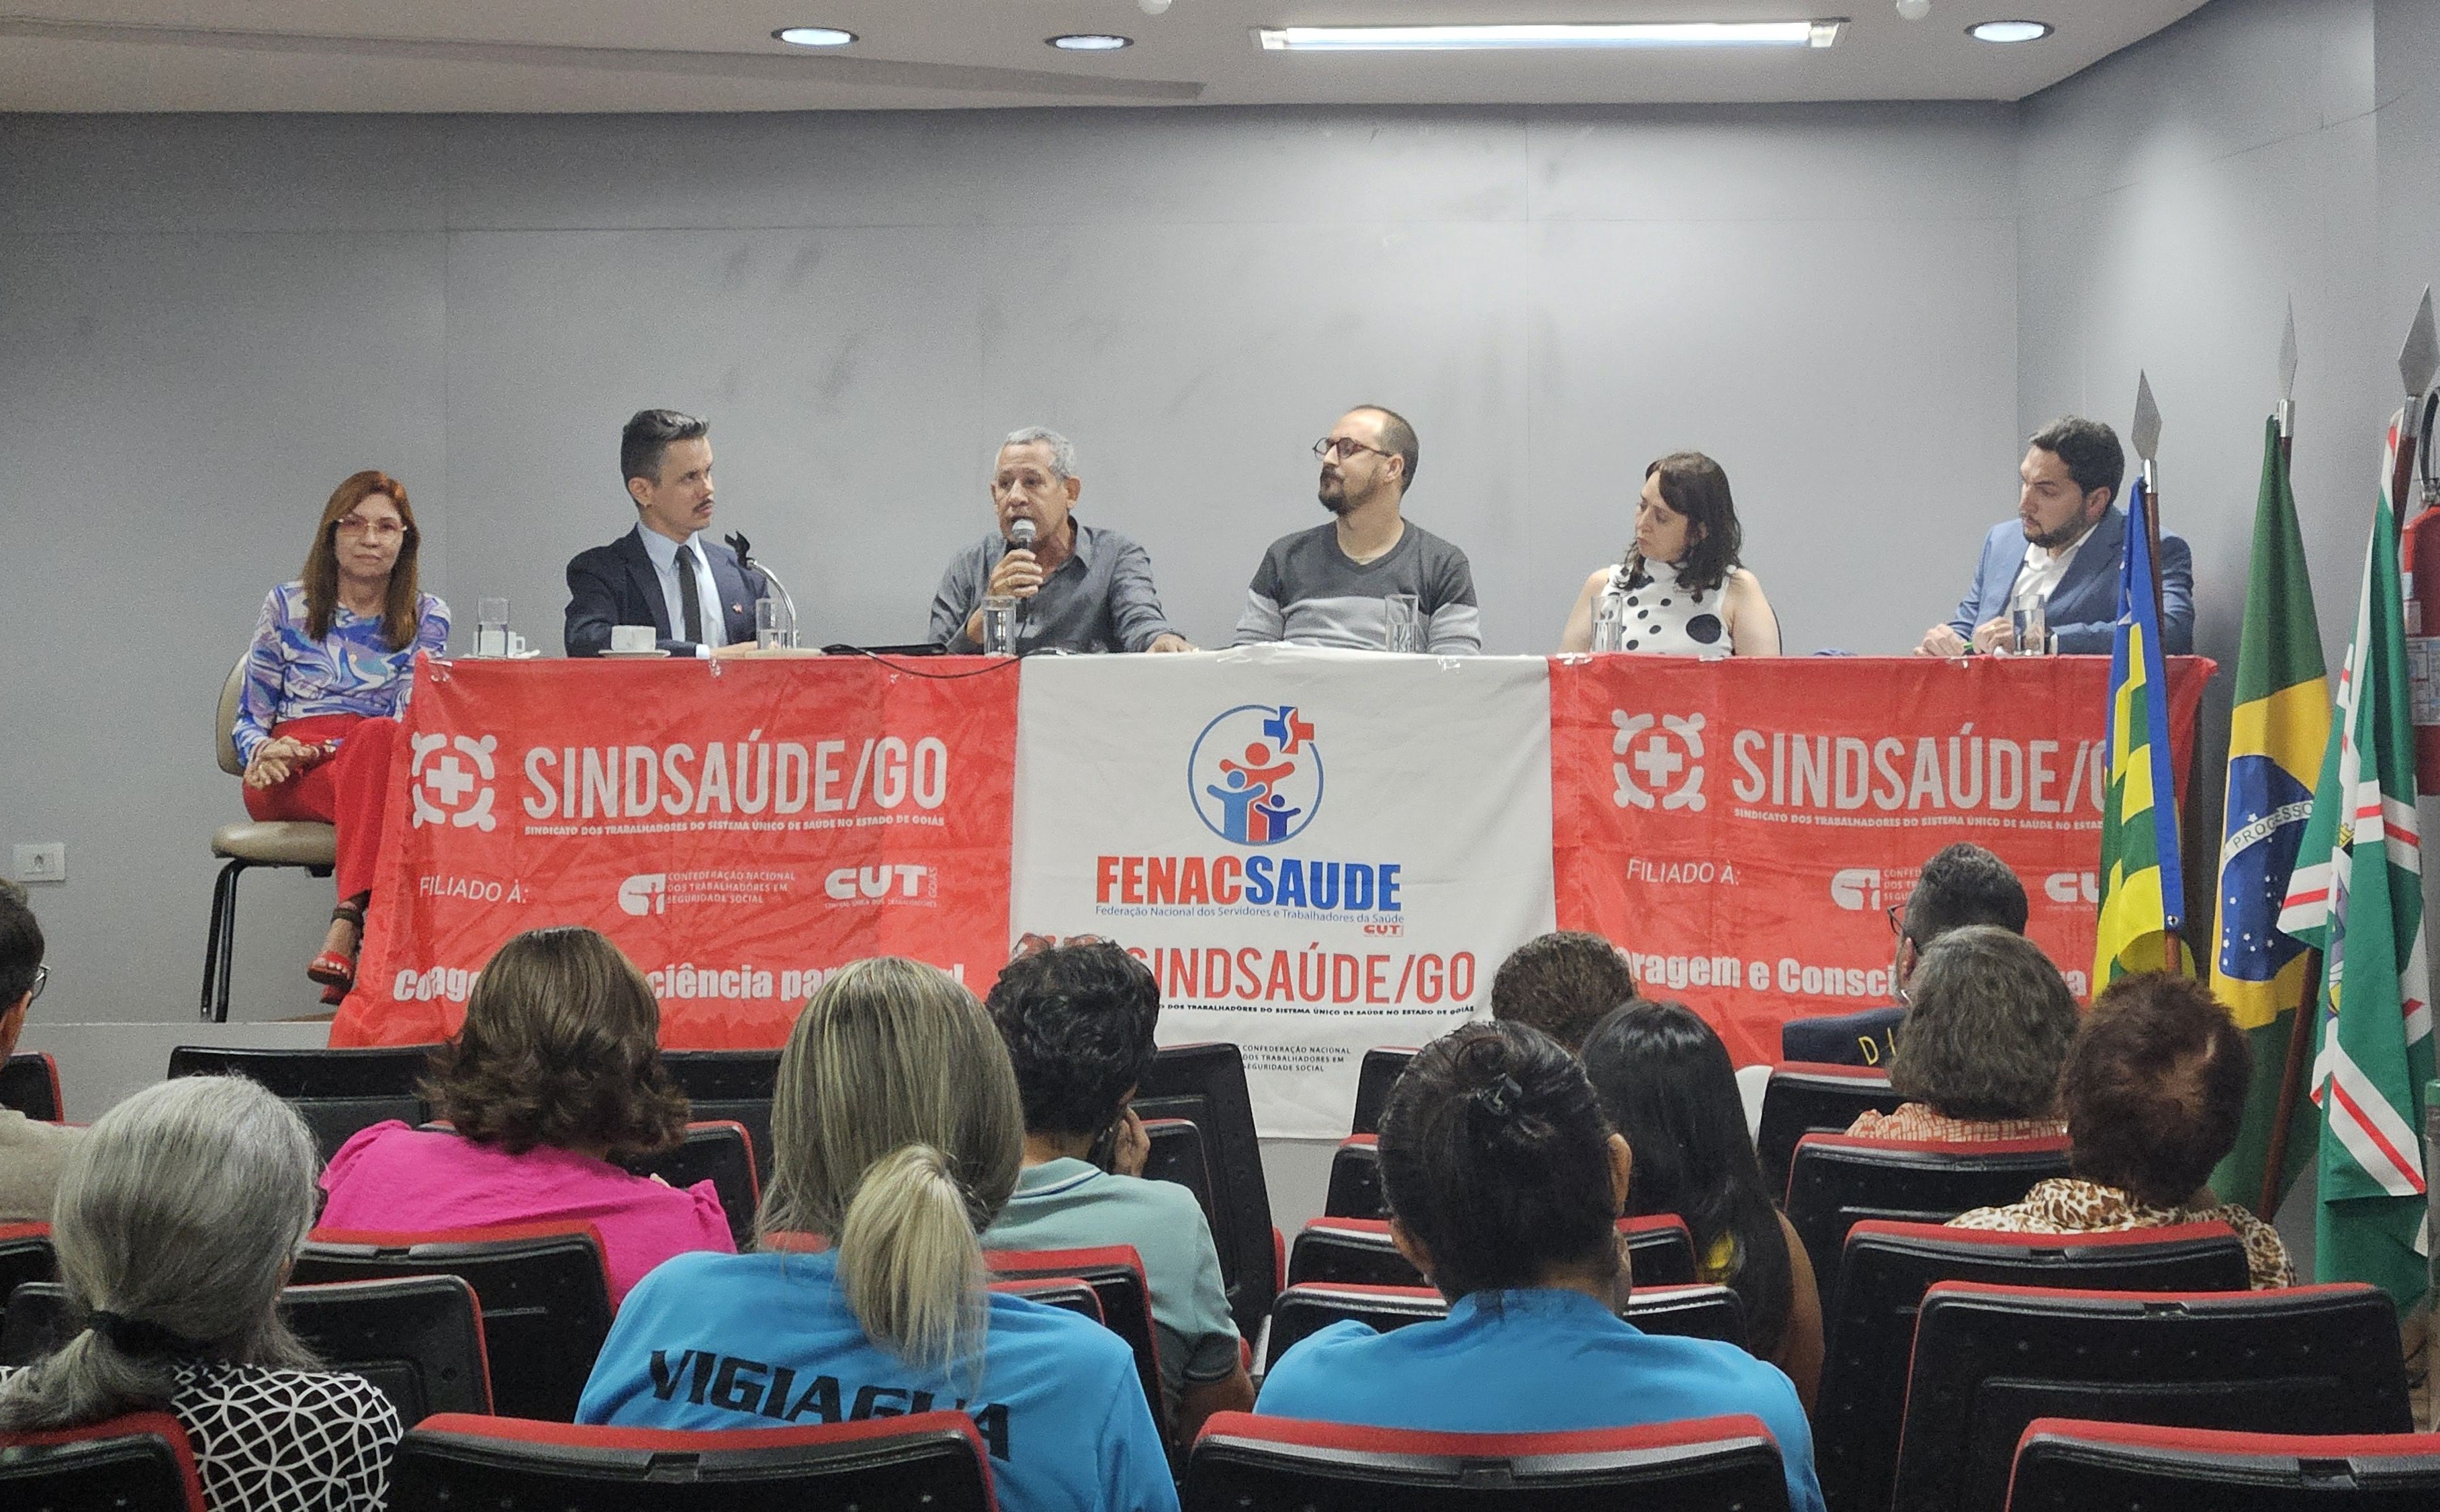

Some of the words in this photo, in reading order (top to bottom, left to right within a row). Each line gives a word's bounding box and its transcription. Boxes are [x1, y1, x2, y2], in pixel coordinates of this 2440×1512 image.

[523, 729, 947, 819] SINDSAÚDE/GO
[1732, 722, 2105, 814] SINDSAÚDE/
[524, 825, 578, 836] SINDICATO
[581, 825, 603, 836] DOS
[604, 821, 688, 835] TRABALHADORES
[689, 820, 705, 832] DO
[707, 819, 750, 831] SISTEMA
[752, 818, 784, 831] ÚNICO
[787, 820, 801, 831] DE
[803, 817, 835, 830] SAÚDE
[837, 818, 853, 829] NO
[856, 814, 893, 827] ESTADO
[896, 814, 909, 824] DE
[1733, 808, 1788, 823] SINDICATO
[1791, 814, 1812, 824] DOS
[1815, 815, 1901, 828] TRABALHADORES
[1903, 818, 1918, 827] DO
[1921, 816, 1964, 826] SISTEMA
[2003, 817, 2017, 828] DE
[2056, 821, 2071, 831] NO
[668, 871, 743, 883] CONFEDERAÇÃO
[746, 871, 796, 882] NACIONAL
[1627, 858, 1715, 884] FILIADO
[419, 876, 502, 902] FILIADO
[506, 878, 529, 904] À:
[668, 884, 687, 893] DOS
[689, 882, 770, 892] TRABALHADORES
[773, 883, 788, 892] EM
[824, 864, 928, 900] CUT
[1096, 855, 1401, 911] FENACSAUDE
[1884, 880, 1903, 890] DOS
[668, 894, 726, 904] SEGURIDADE
[730, 894, 764, 904] SOCIAL
[1095, 906, 1148, 917] Federação
[1150, 906, 1194, 916] Nacional
[1197, 906, 1215, 916] dos
[1218, 906, 1271, 916] Servidores
[1281, 909, 1354, 923] Trabalhadores
[1357, 913, 1369, 923] da
[1372, 912, 1404, 925] Saúde
[1363, 925, 1400, 935] CUT
[1748, 961, 1770, 991] e
[1778, 957, 1897, 997] Consci
[1187, 1004, 1258, 1012] TRABALHADORES
[1313, 1007, 1340, 1016] ÚNICO
[1357, 1008, 1384, 1016] SAÚDE
[1242, 1045, 1307, 1054] CONFEDERAÇÃO
[1261, 1054, 1330, 1063] TRABALHADORES
